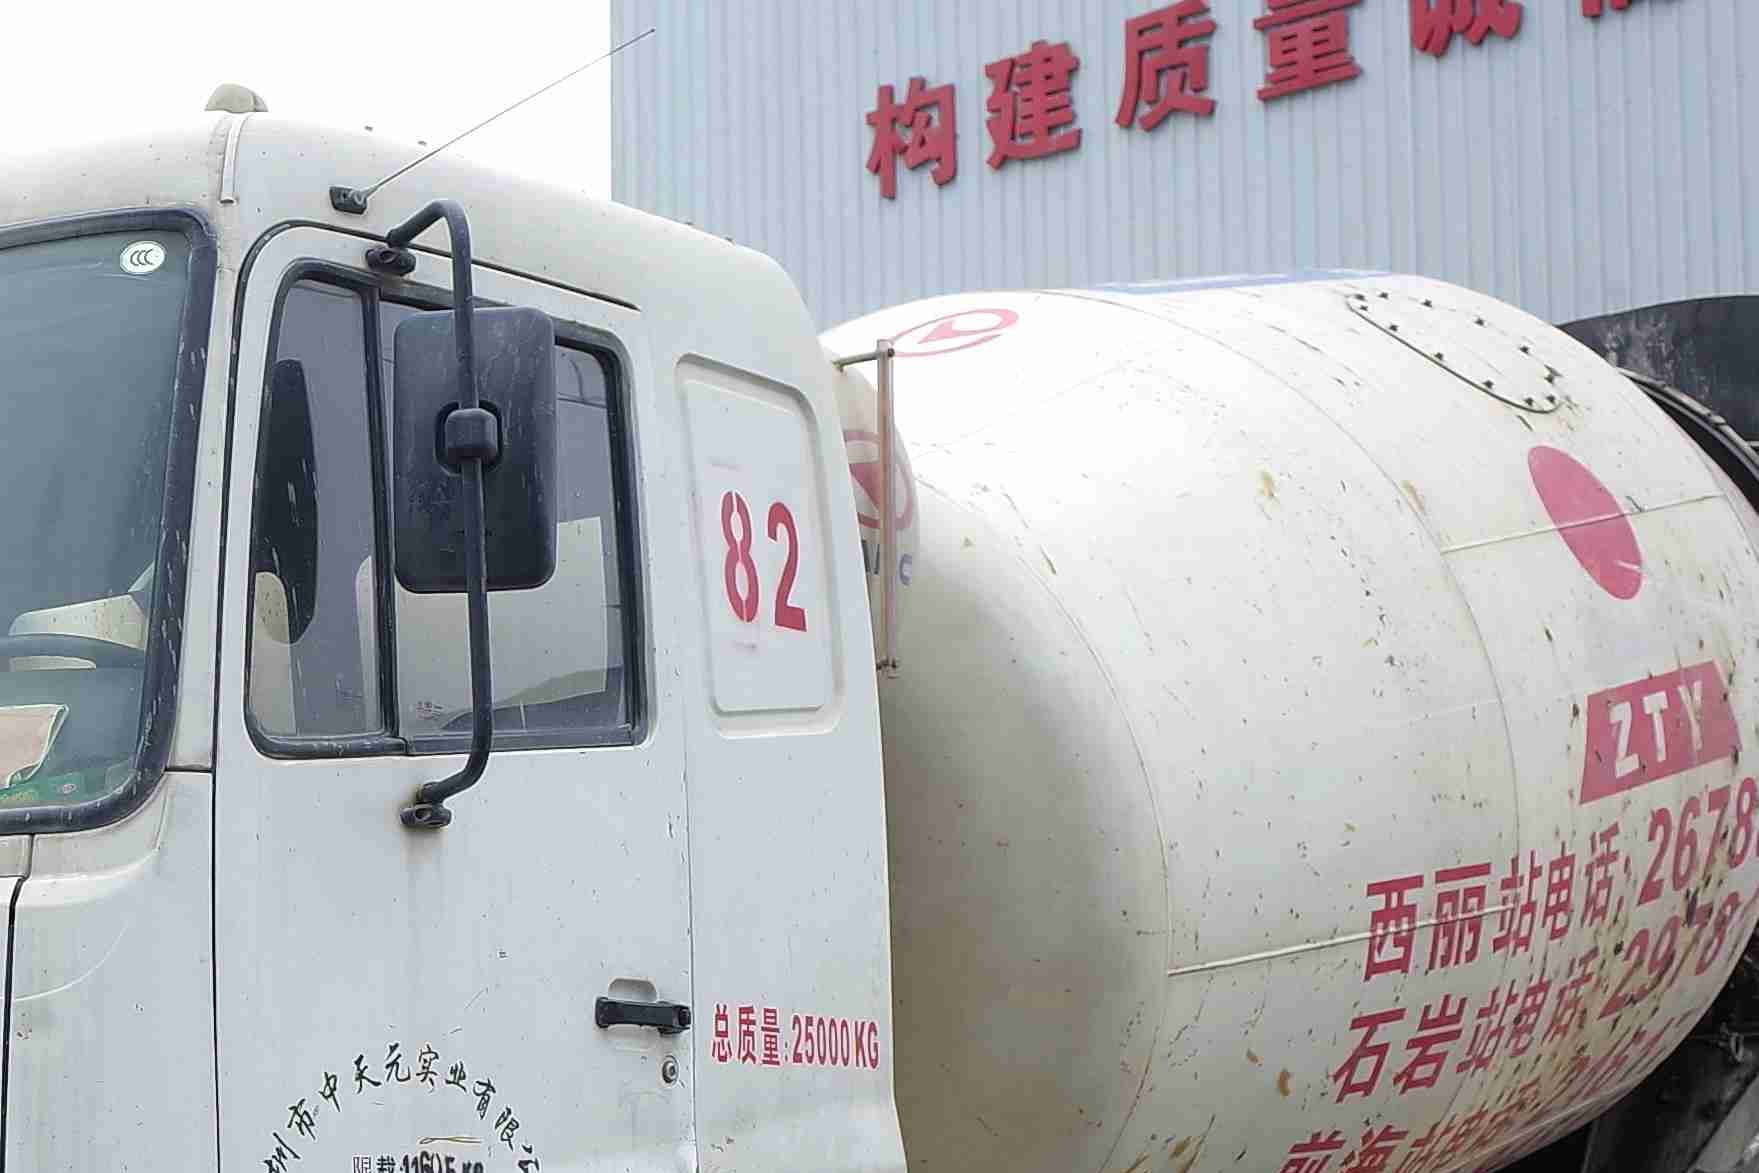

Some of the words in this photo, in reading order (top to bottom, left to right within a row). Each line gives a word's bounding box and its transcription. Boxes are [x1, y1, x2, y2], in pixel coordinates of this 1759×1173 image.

[866, 0, 1675, 199] 构建质量
[720, 490, 808, 632] 82
[1606, 680, 1704, 779] ZTY
[1364, 776, 1759, 983] 西丽站电话:2678
[711, 1003, 880, 1069] 总质量:25000KG
